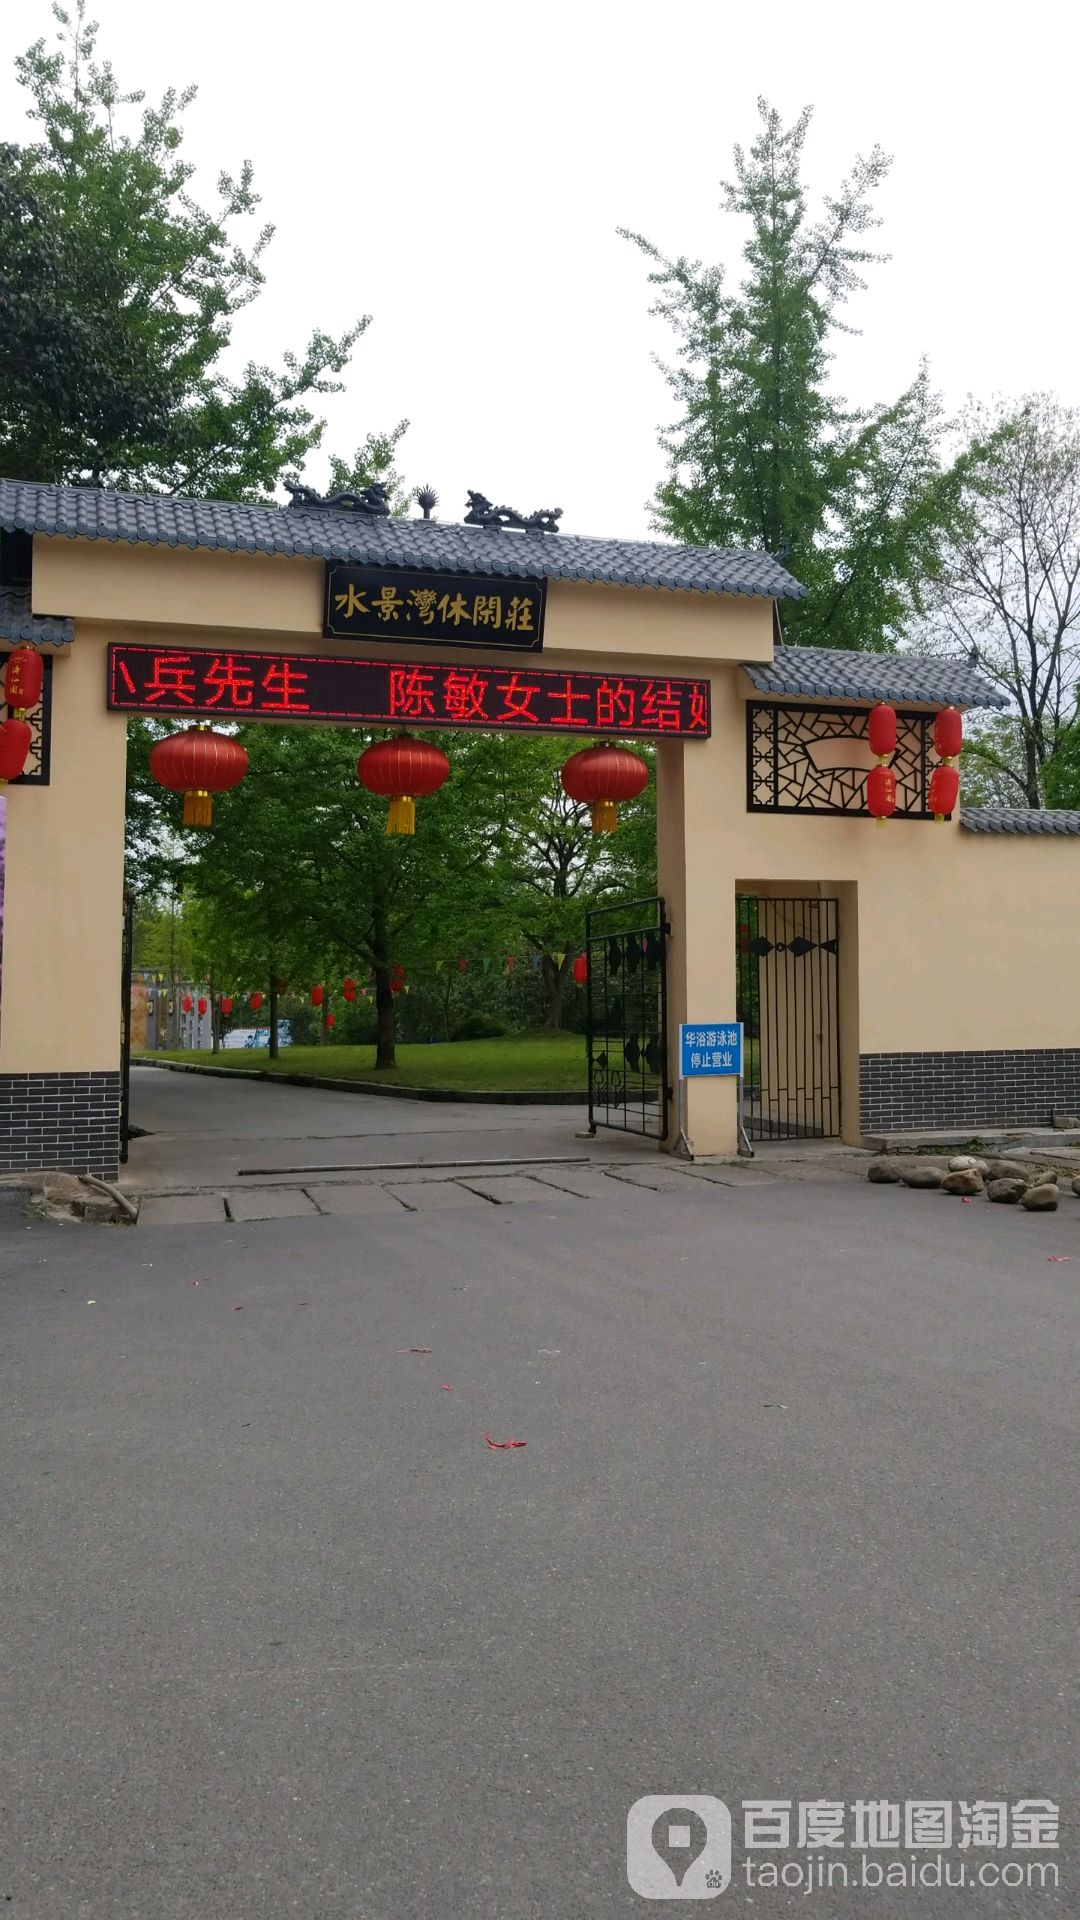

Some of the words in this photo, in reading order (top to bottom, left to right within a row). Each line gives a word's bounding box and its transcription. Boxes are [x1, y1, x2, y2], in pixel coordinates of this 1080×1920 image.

[119, 656, 310, 710] 兵先生
[691, 1051, 733, 1069] 停止营业
